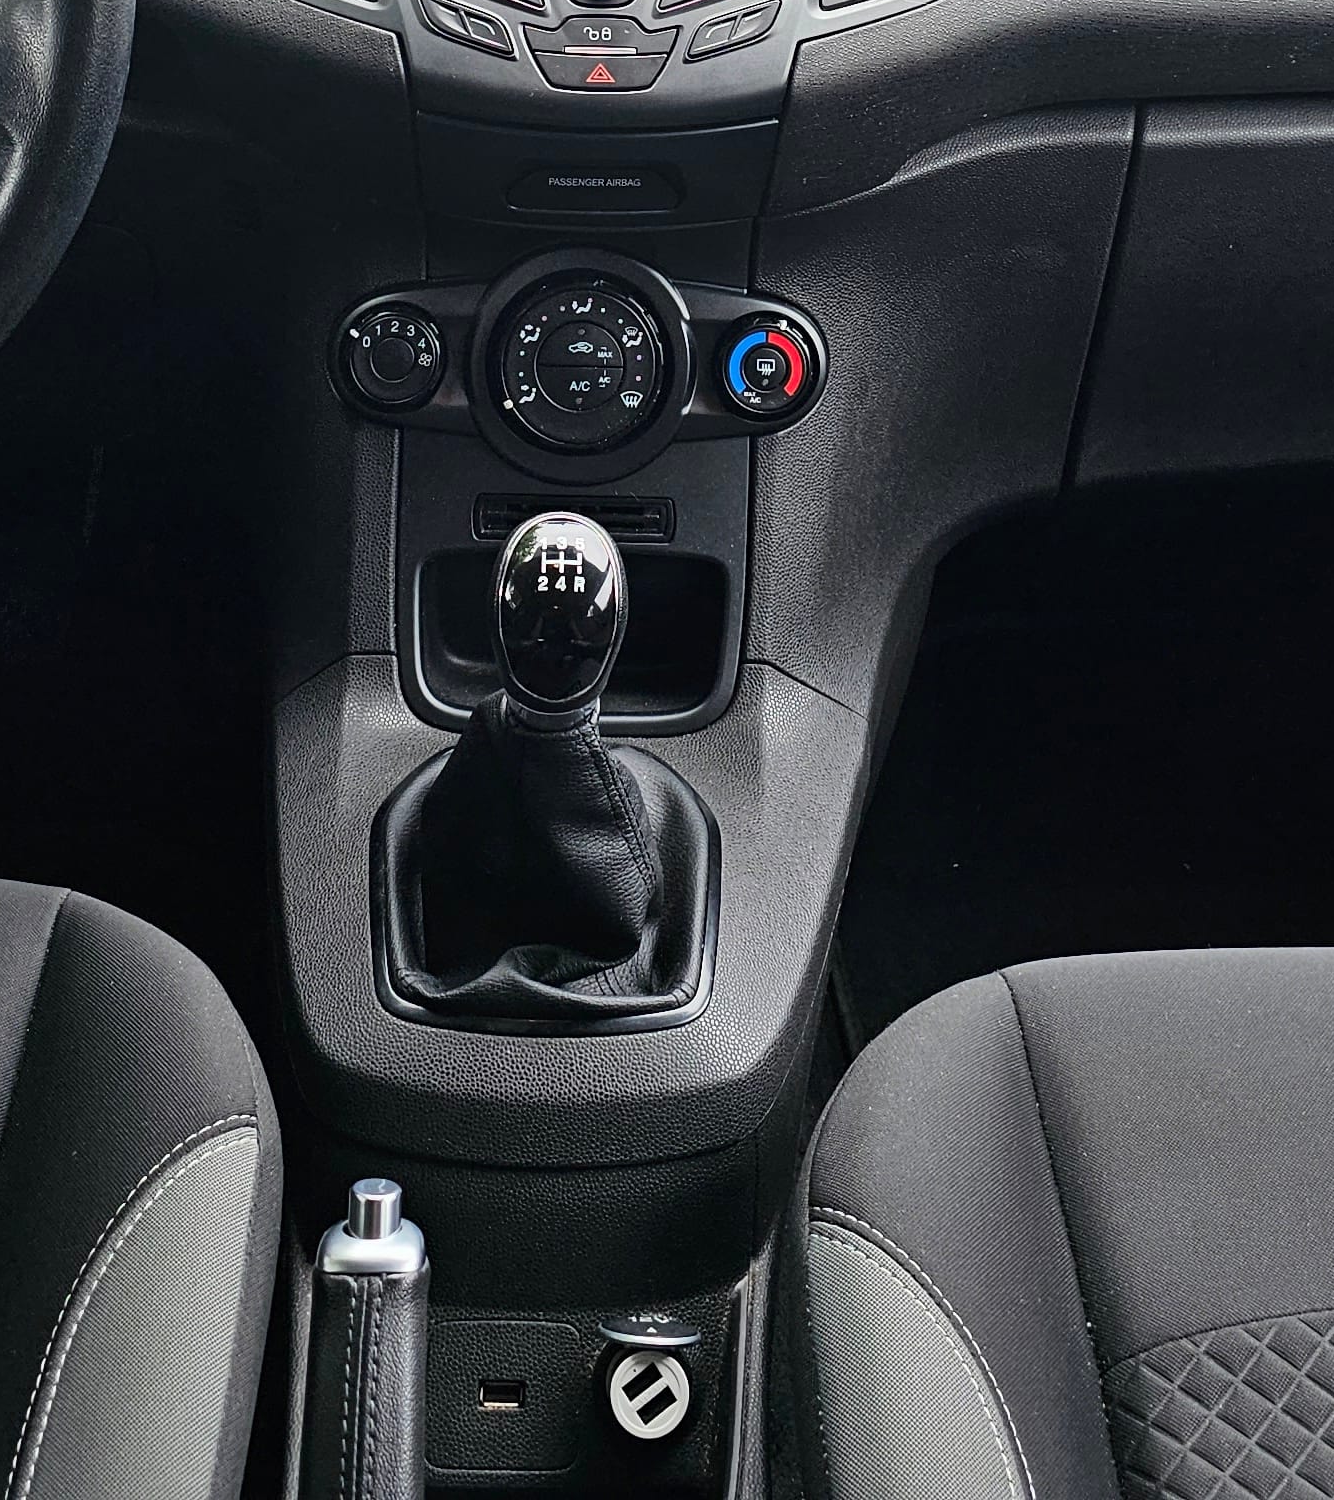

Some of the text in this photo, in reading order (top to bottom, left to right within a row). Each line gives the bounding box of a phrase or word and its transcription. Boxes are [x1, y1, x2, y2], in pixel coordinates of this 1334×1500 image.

[548, 177, 642, 187] PASSENGER AIRBAG
[362, 320, 426, 349] 0 1 2 3 4
[597, 351, 614, 359] MAX
[569, 380, 591, 392] A/C
[598, 376, 612, 385] A/C
[540, 536, 585, 551] 1 3 5
[537, 575, 586, 593] 2 4 R
